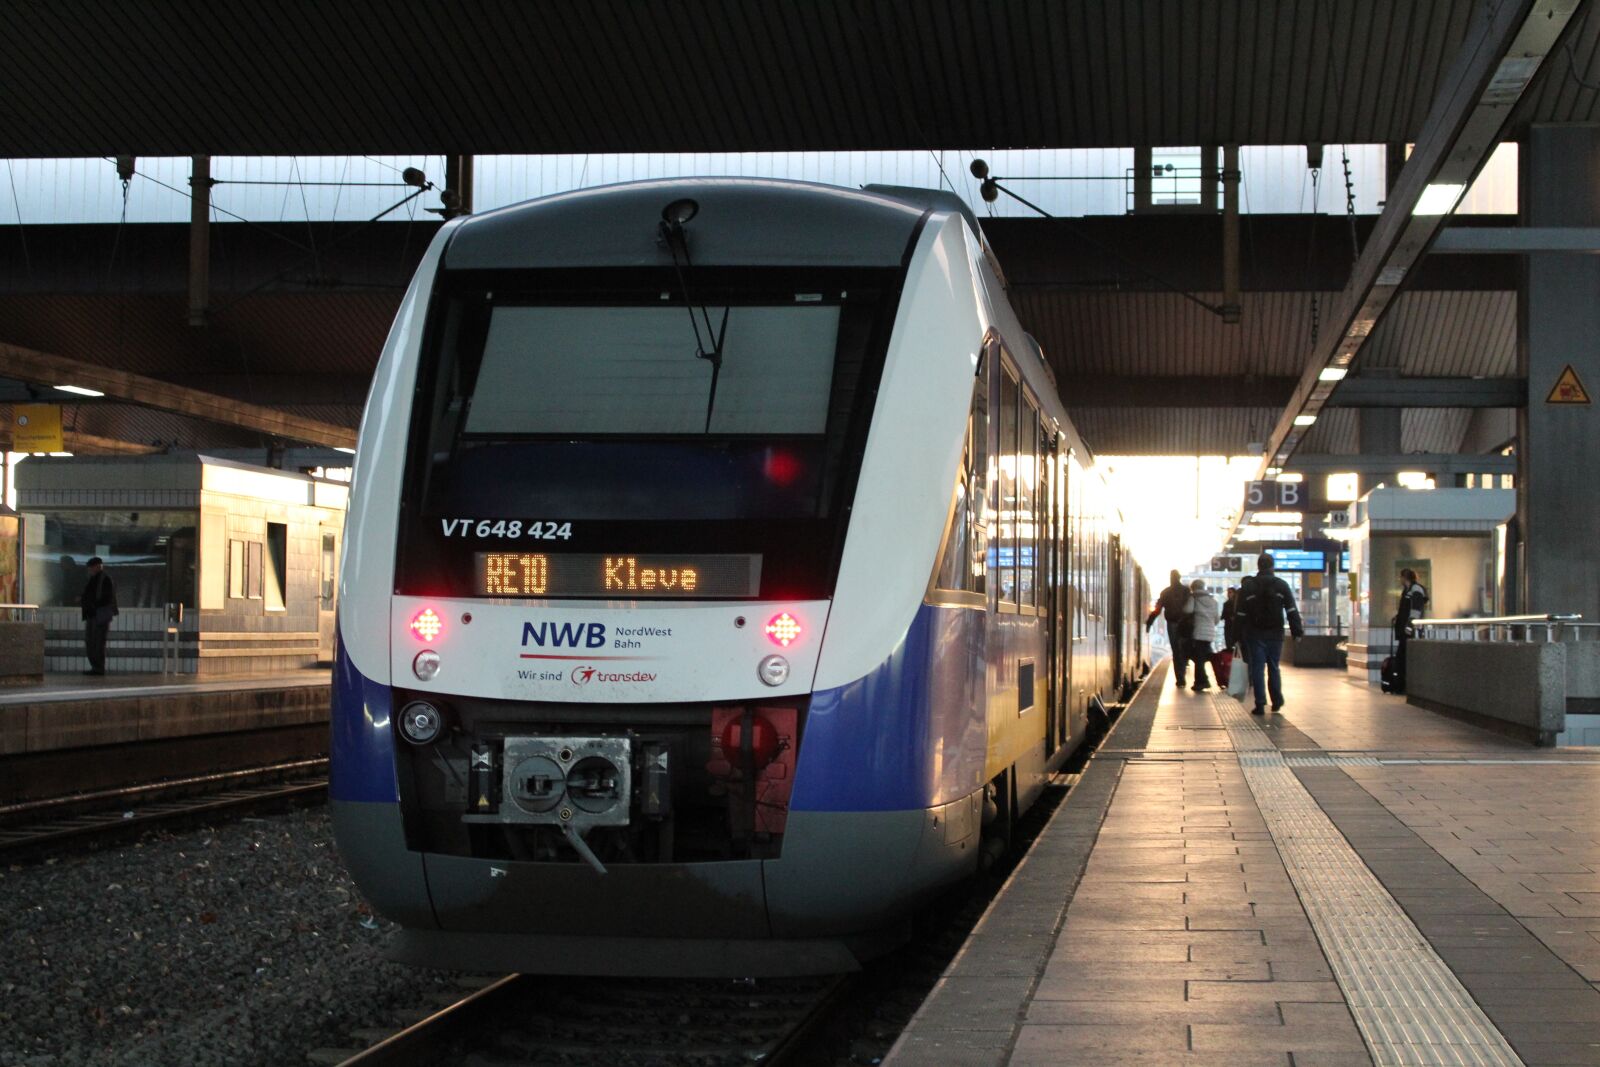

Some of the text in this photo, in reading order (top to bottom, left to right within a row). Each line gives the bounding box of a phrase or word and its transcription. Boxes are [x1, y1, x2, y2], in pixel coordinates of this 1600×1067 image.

[1248, 481, 1299, 505] 5 B
[441, 519, 572, 540] VT 648 424
[486, 554, 697, 594] RE10 Kleve
[521, 621, 606, 648] NWB
[615, 627, 672, 636] NordWest
[614, 640, 641, 649] Bahn
[518, 670, 657, 683] Wir sind transdev
